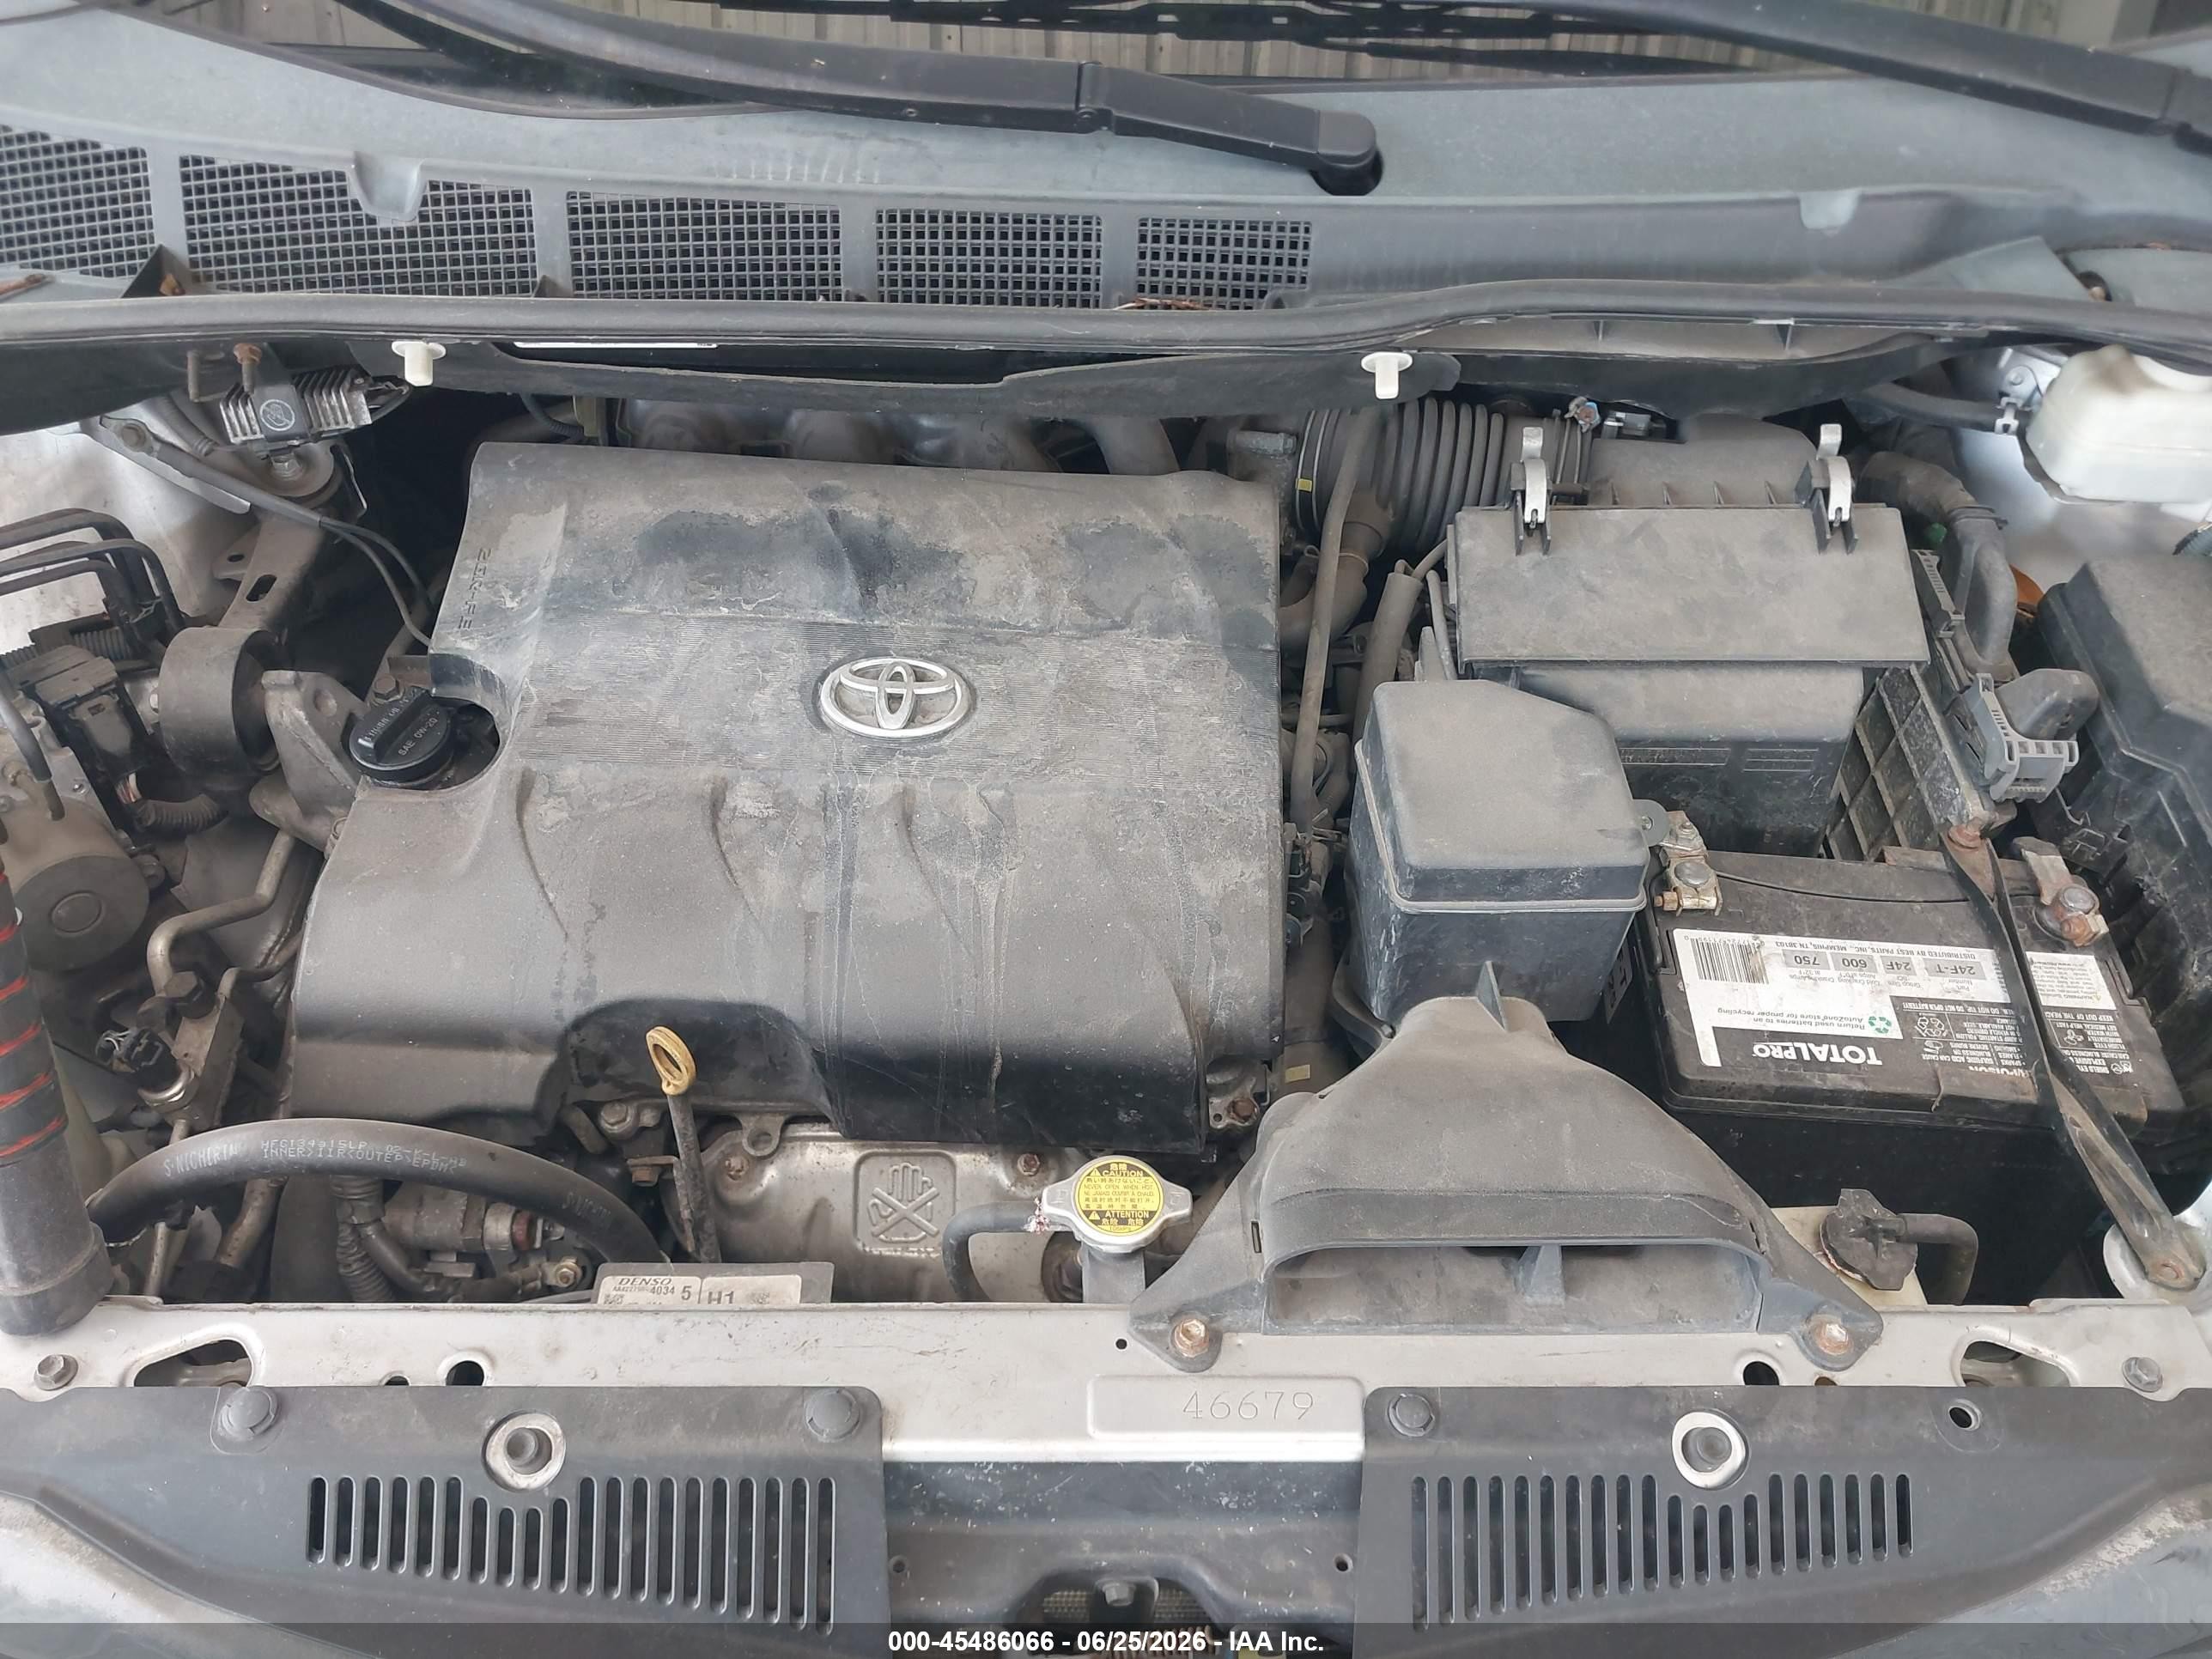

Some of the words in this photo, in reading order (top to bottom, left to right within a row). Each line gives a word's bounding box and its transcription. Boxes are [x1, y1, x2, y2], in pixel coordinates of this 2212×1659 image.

[398, 740, 416, 756] SAE
[1795, 955, 1820, 966] 750
[1842, 958, 1867, 969] 600
[1886, 961, 1911, 970] 24F
[1936, 963, 1975, 975] 24F-T
[1717, 1008, 1754, 1017] recycling
[1776, 1018, 1812, 1027] batteries
[1837, 1022, 1865, 1030] Return
[1753, 1042, 1882, 1066] TOTALPRO
[681, 1285, 691, 1300] 5
[708, 1291, 734, 1304] H1
[1183, 1390, 1313, 1419] 46679
